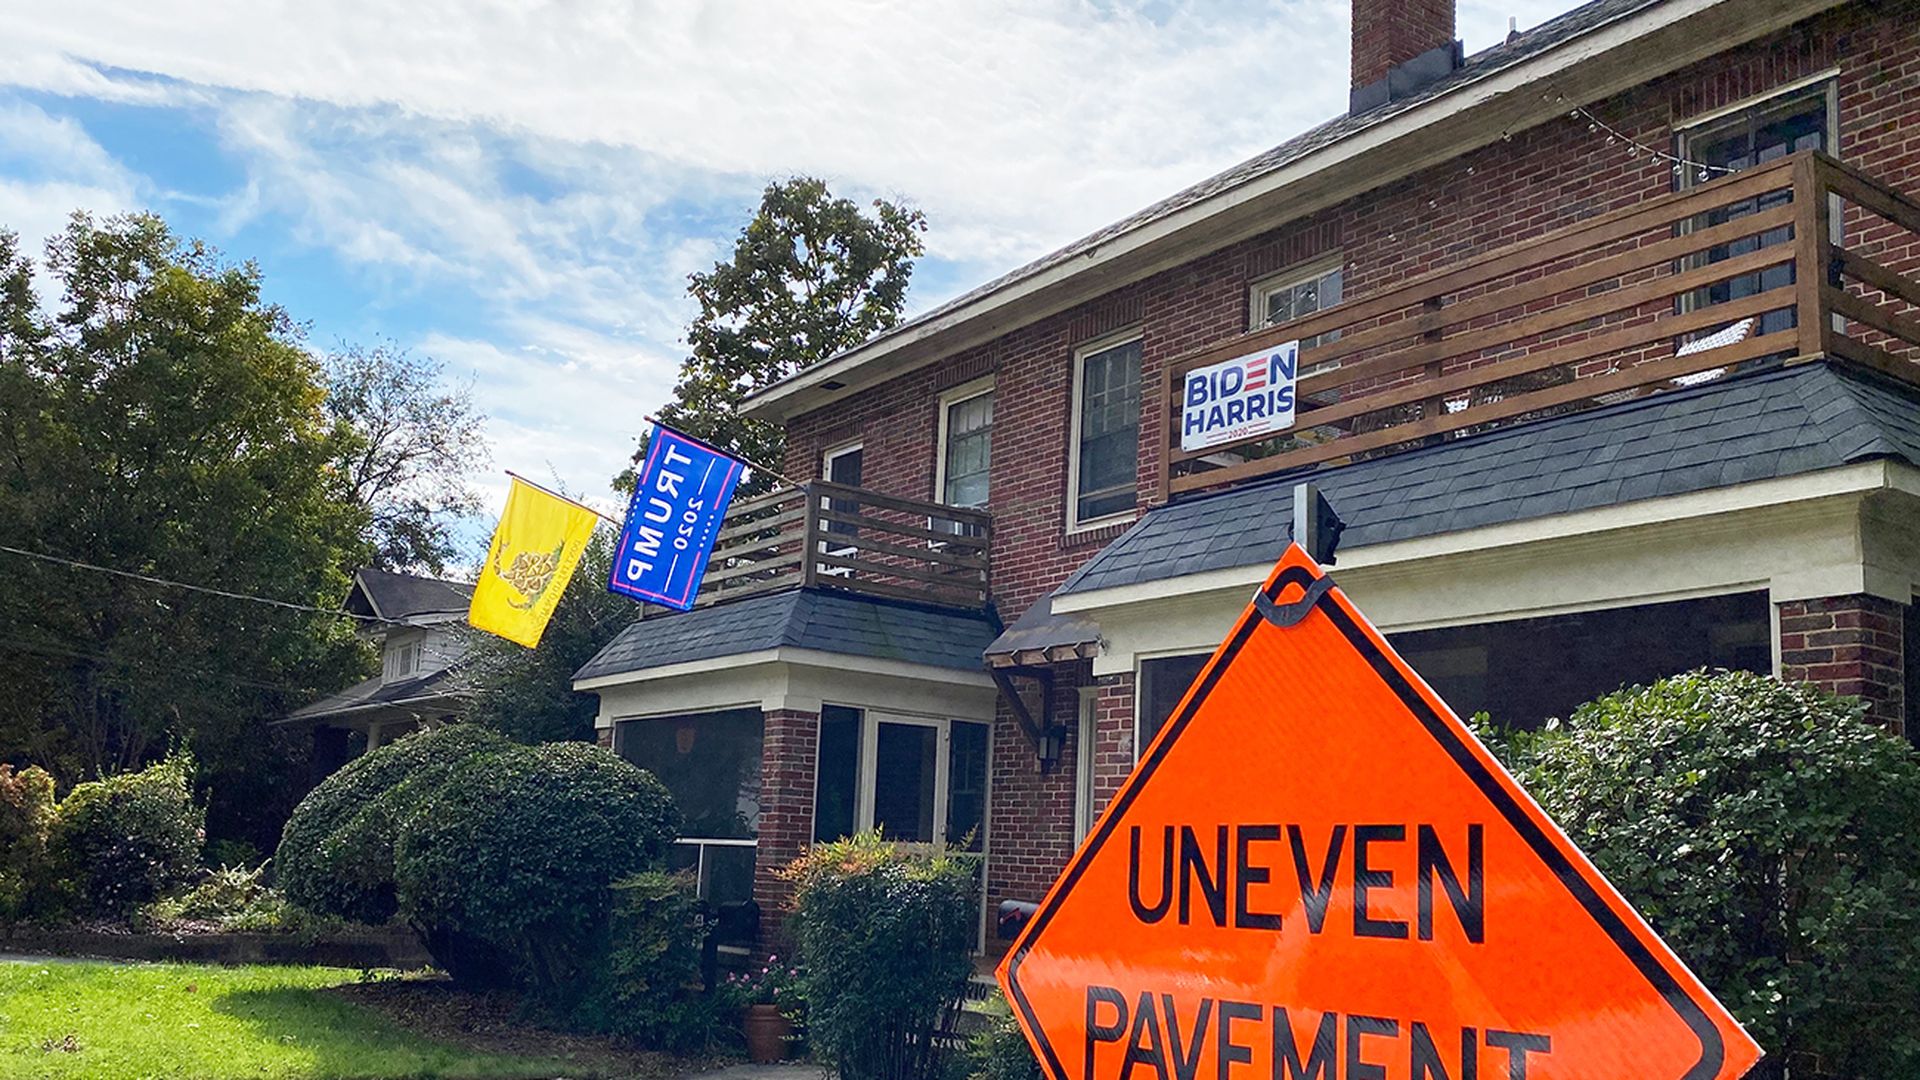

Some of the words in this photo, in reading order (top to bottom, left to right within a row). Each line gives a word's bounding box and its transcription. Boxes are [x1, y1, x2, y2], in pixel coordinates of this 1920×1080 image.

[1187, 349, 1296, 408] BIDEN
[1185, 386, 1294, 436] HARRIS
[1129, 824, 1484, 944] UNEVEN
